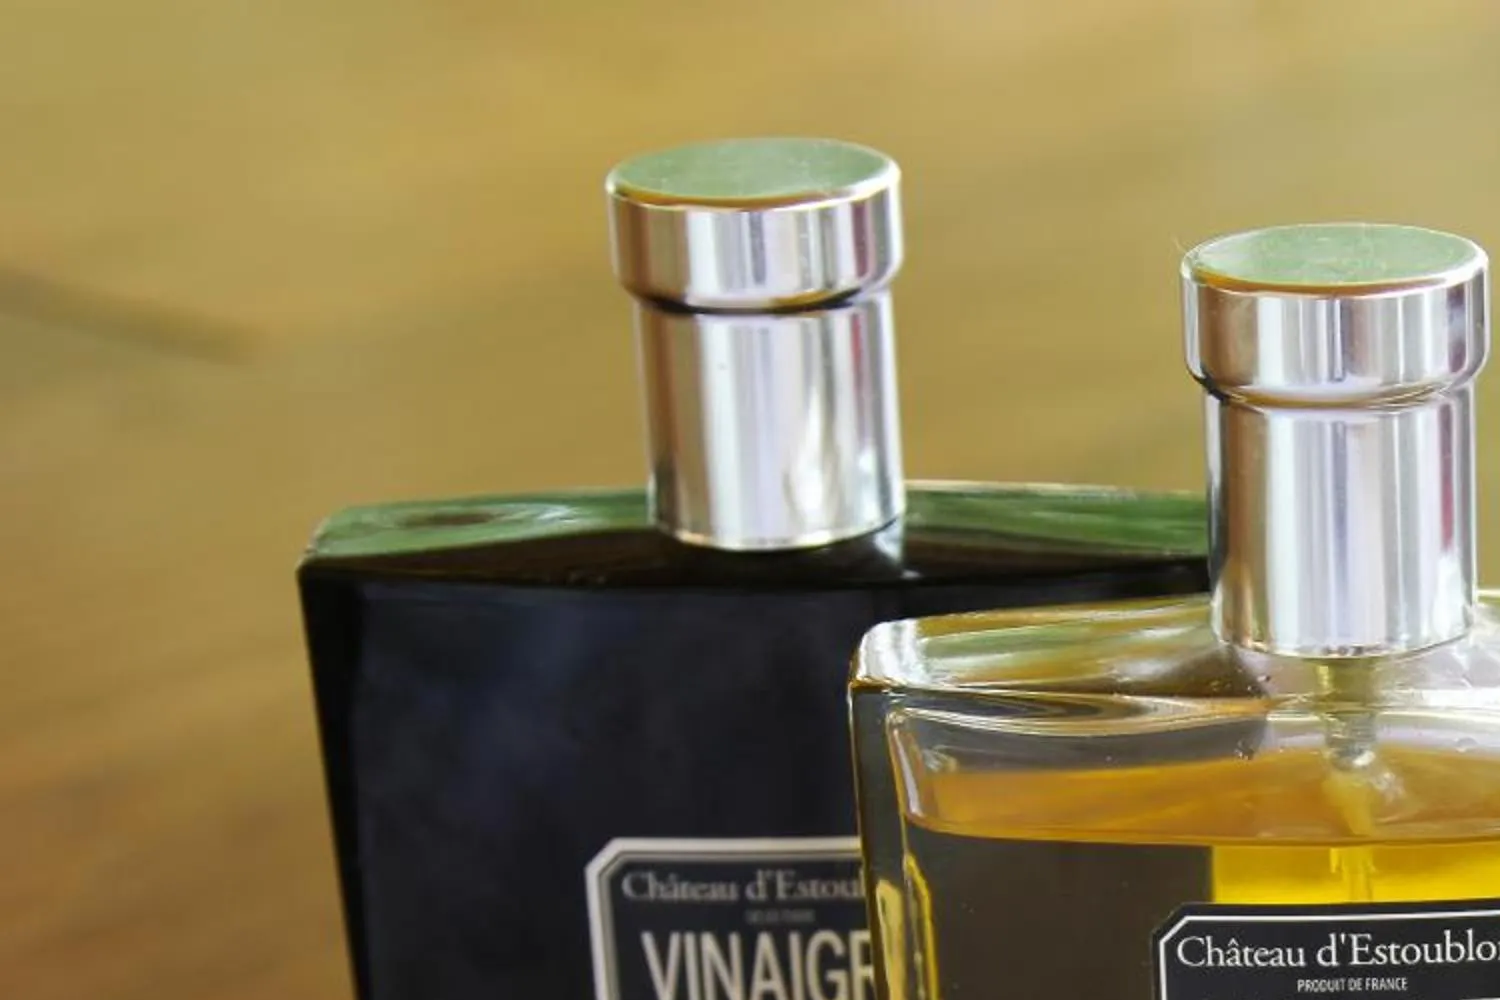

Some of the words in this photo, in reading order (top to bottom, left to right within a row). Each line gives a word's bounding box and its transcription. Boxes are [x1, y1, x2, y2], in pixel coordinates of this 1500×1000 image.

[621, 871, 740, 901] Château
[1176, 936, 1306, 968] Château
[1296, 978, 1345, 993] PRODUIT
[1348, 978, 1363, 992] DE
[1365, 976, 1408, 991] FRANCE
